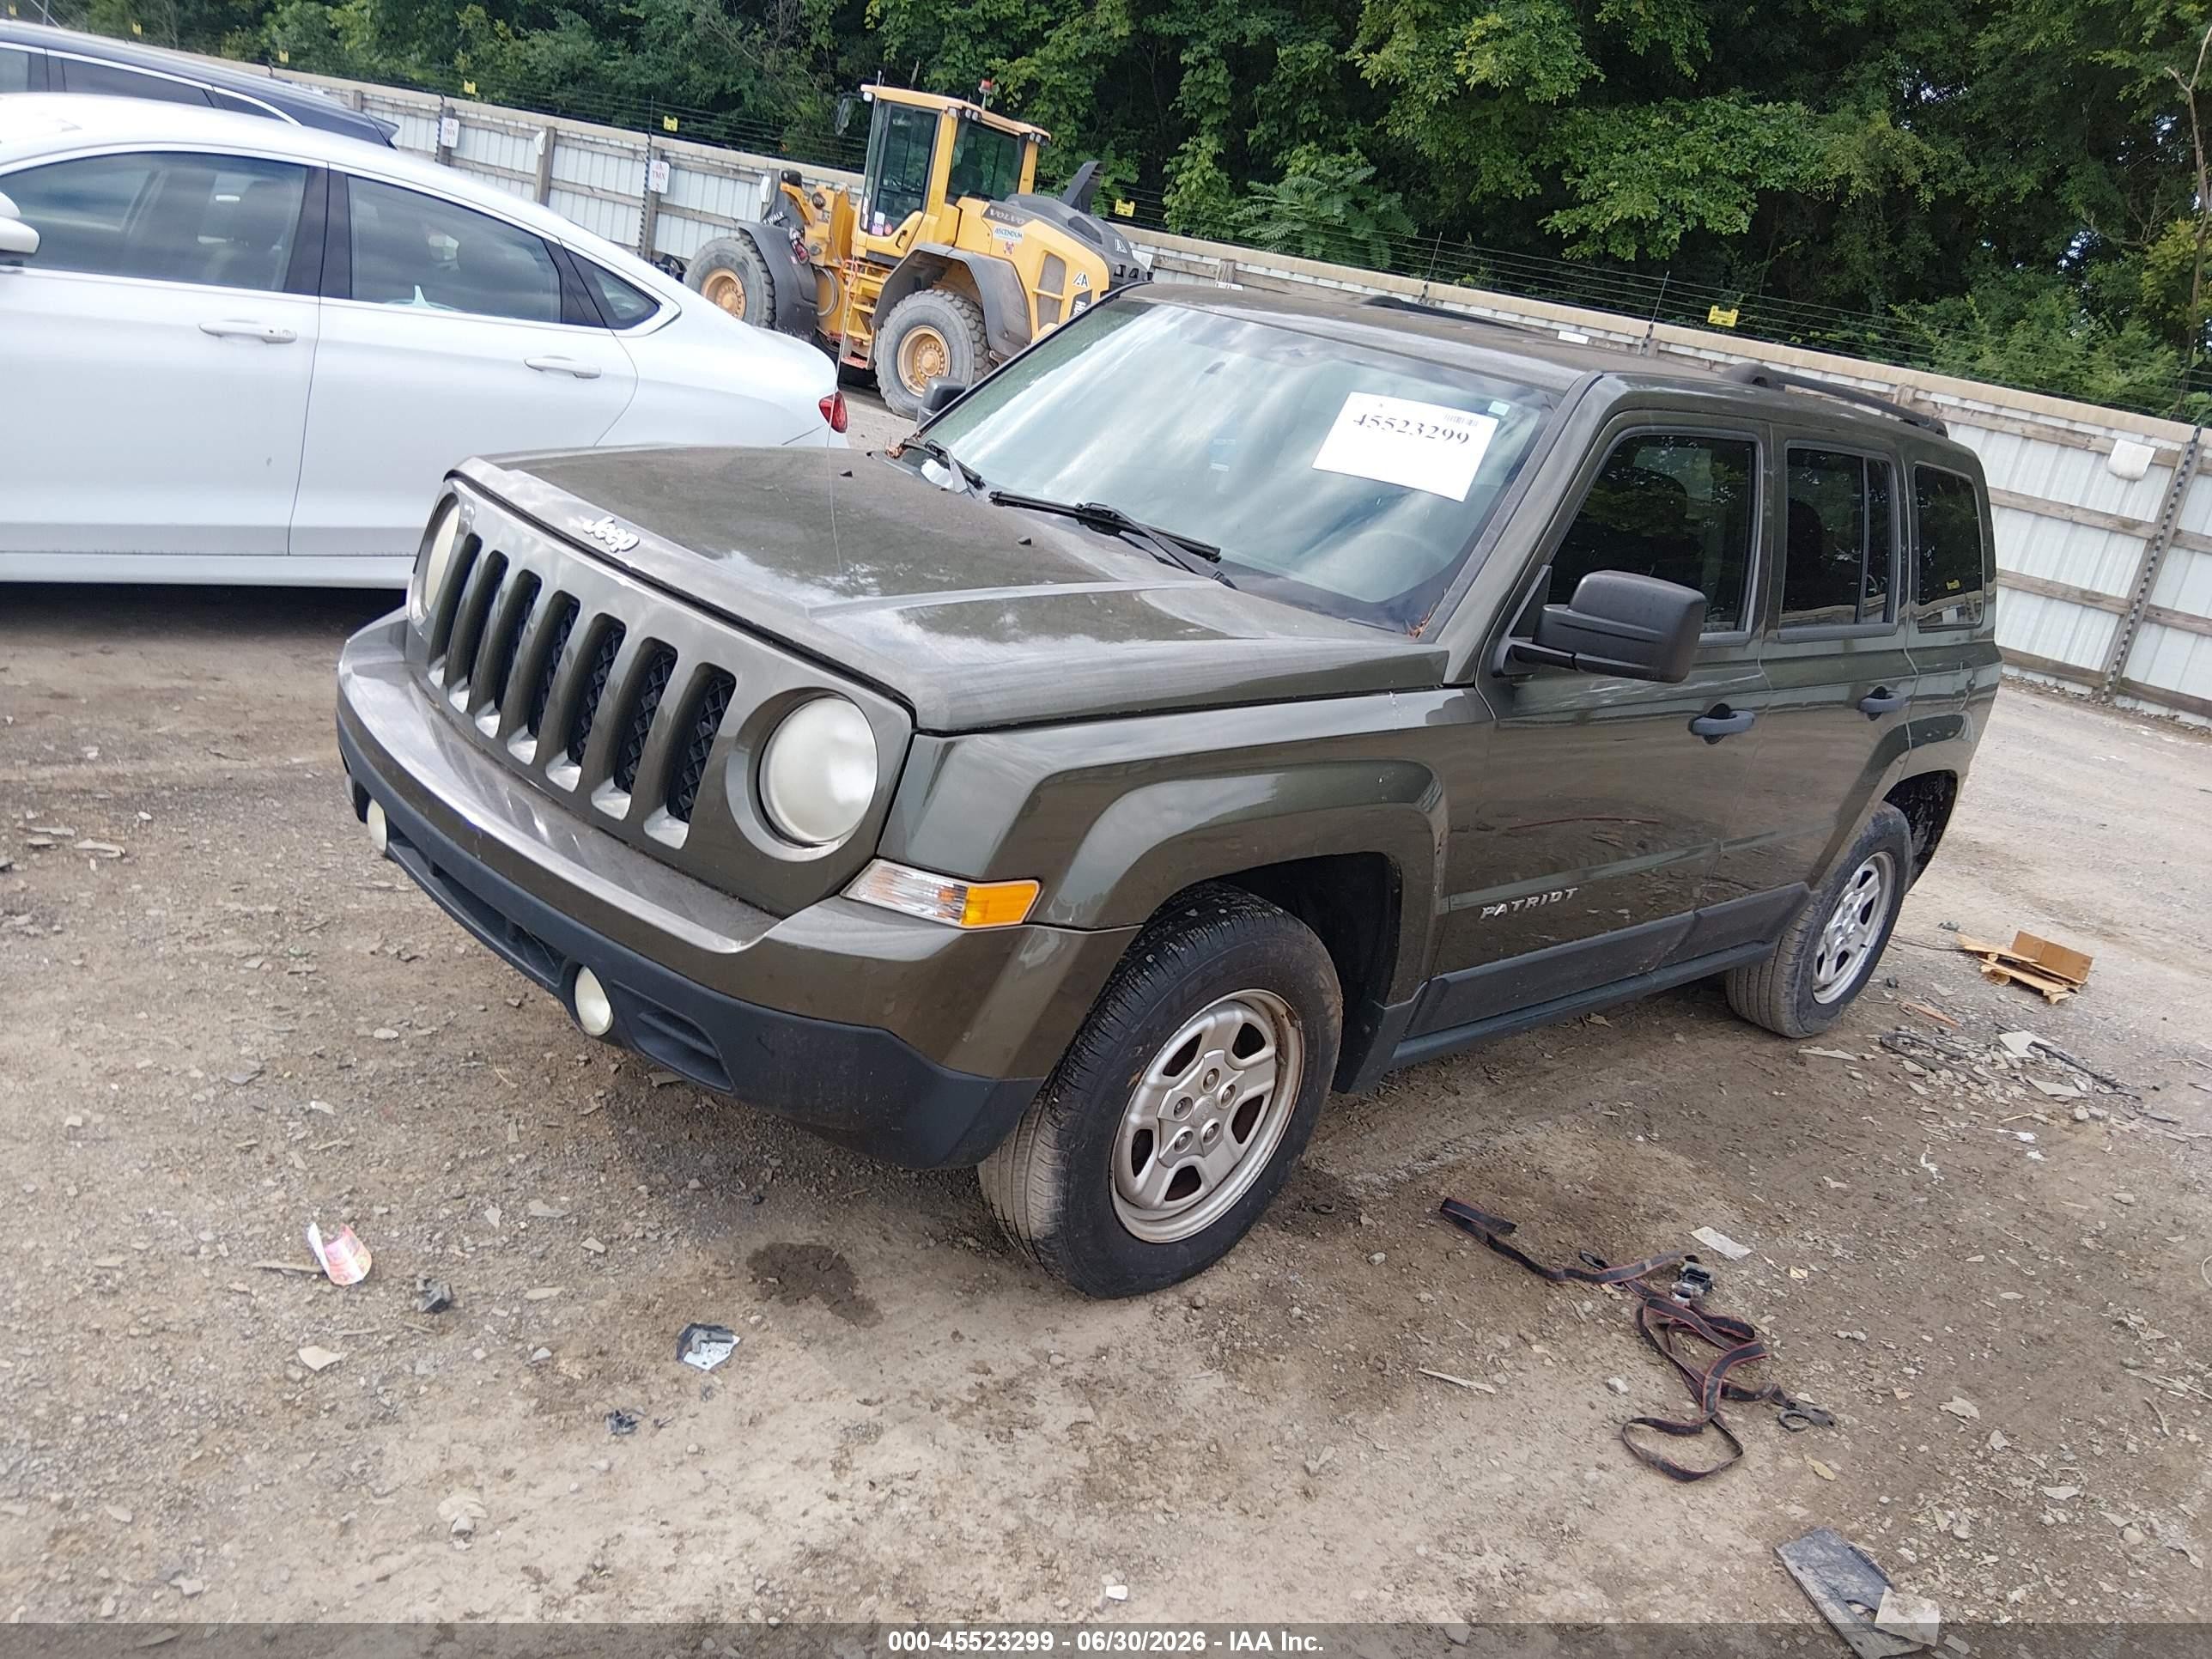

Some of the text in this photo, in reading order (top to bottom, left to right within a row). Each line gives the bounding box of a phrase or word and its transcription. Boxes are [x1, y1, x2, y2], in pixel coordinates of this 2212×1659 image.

[990, 208, 1025, 225] VOLVO
[1353, 413, 1470, 445] 45523299
[583, 516, 641, 554] Jeep
[1480, 887, 1579, 921] PATRIOT
